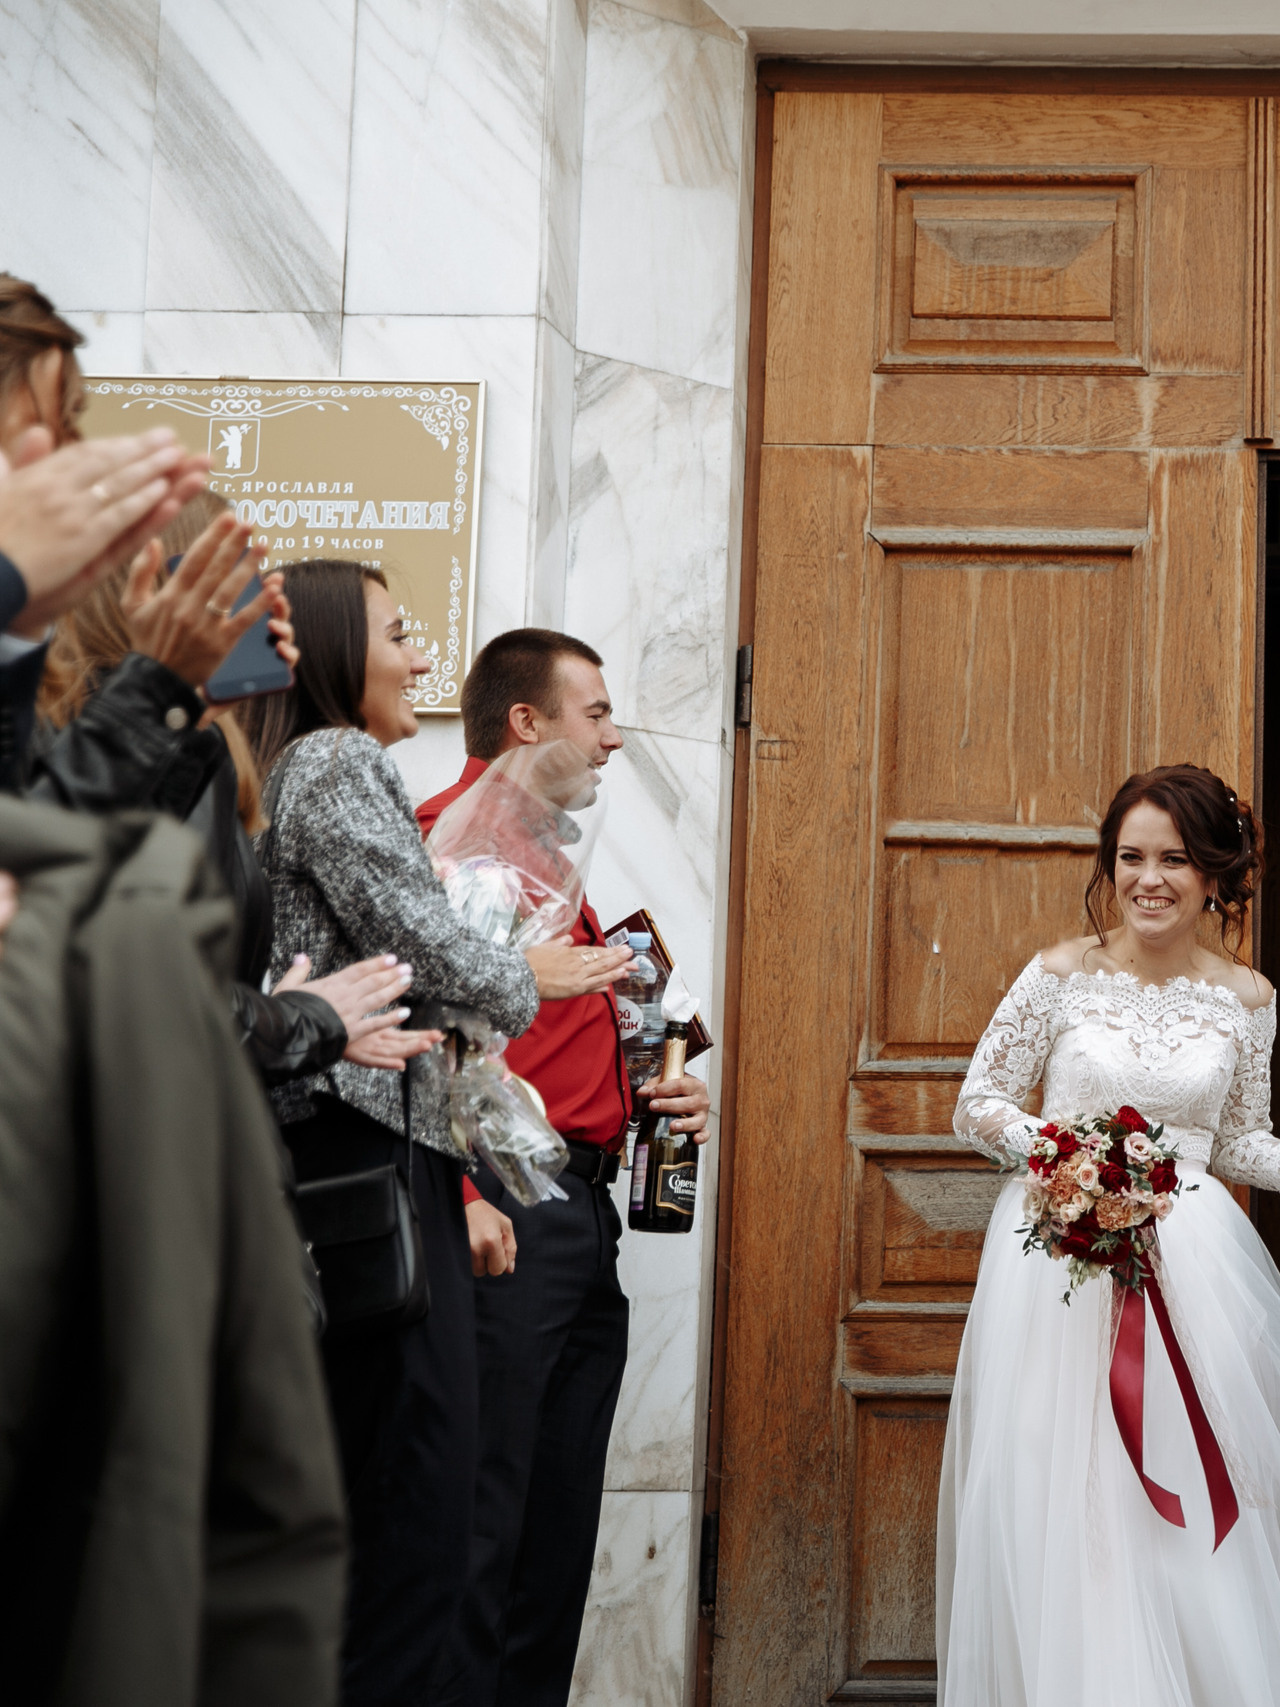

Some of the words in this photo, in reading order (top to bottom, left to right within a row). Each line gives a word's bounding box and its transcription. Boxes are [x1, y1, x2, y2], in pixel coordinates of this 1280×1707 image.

[224, 483, 236, 493] г.
[241, 481, 354, 494] ЯРОСЛАВЛЯ
[302, 535, 325, 549] 19
